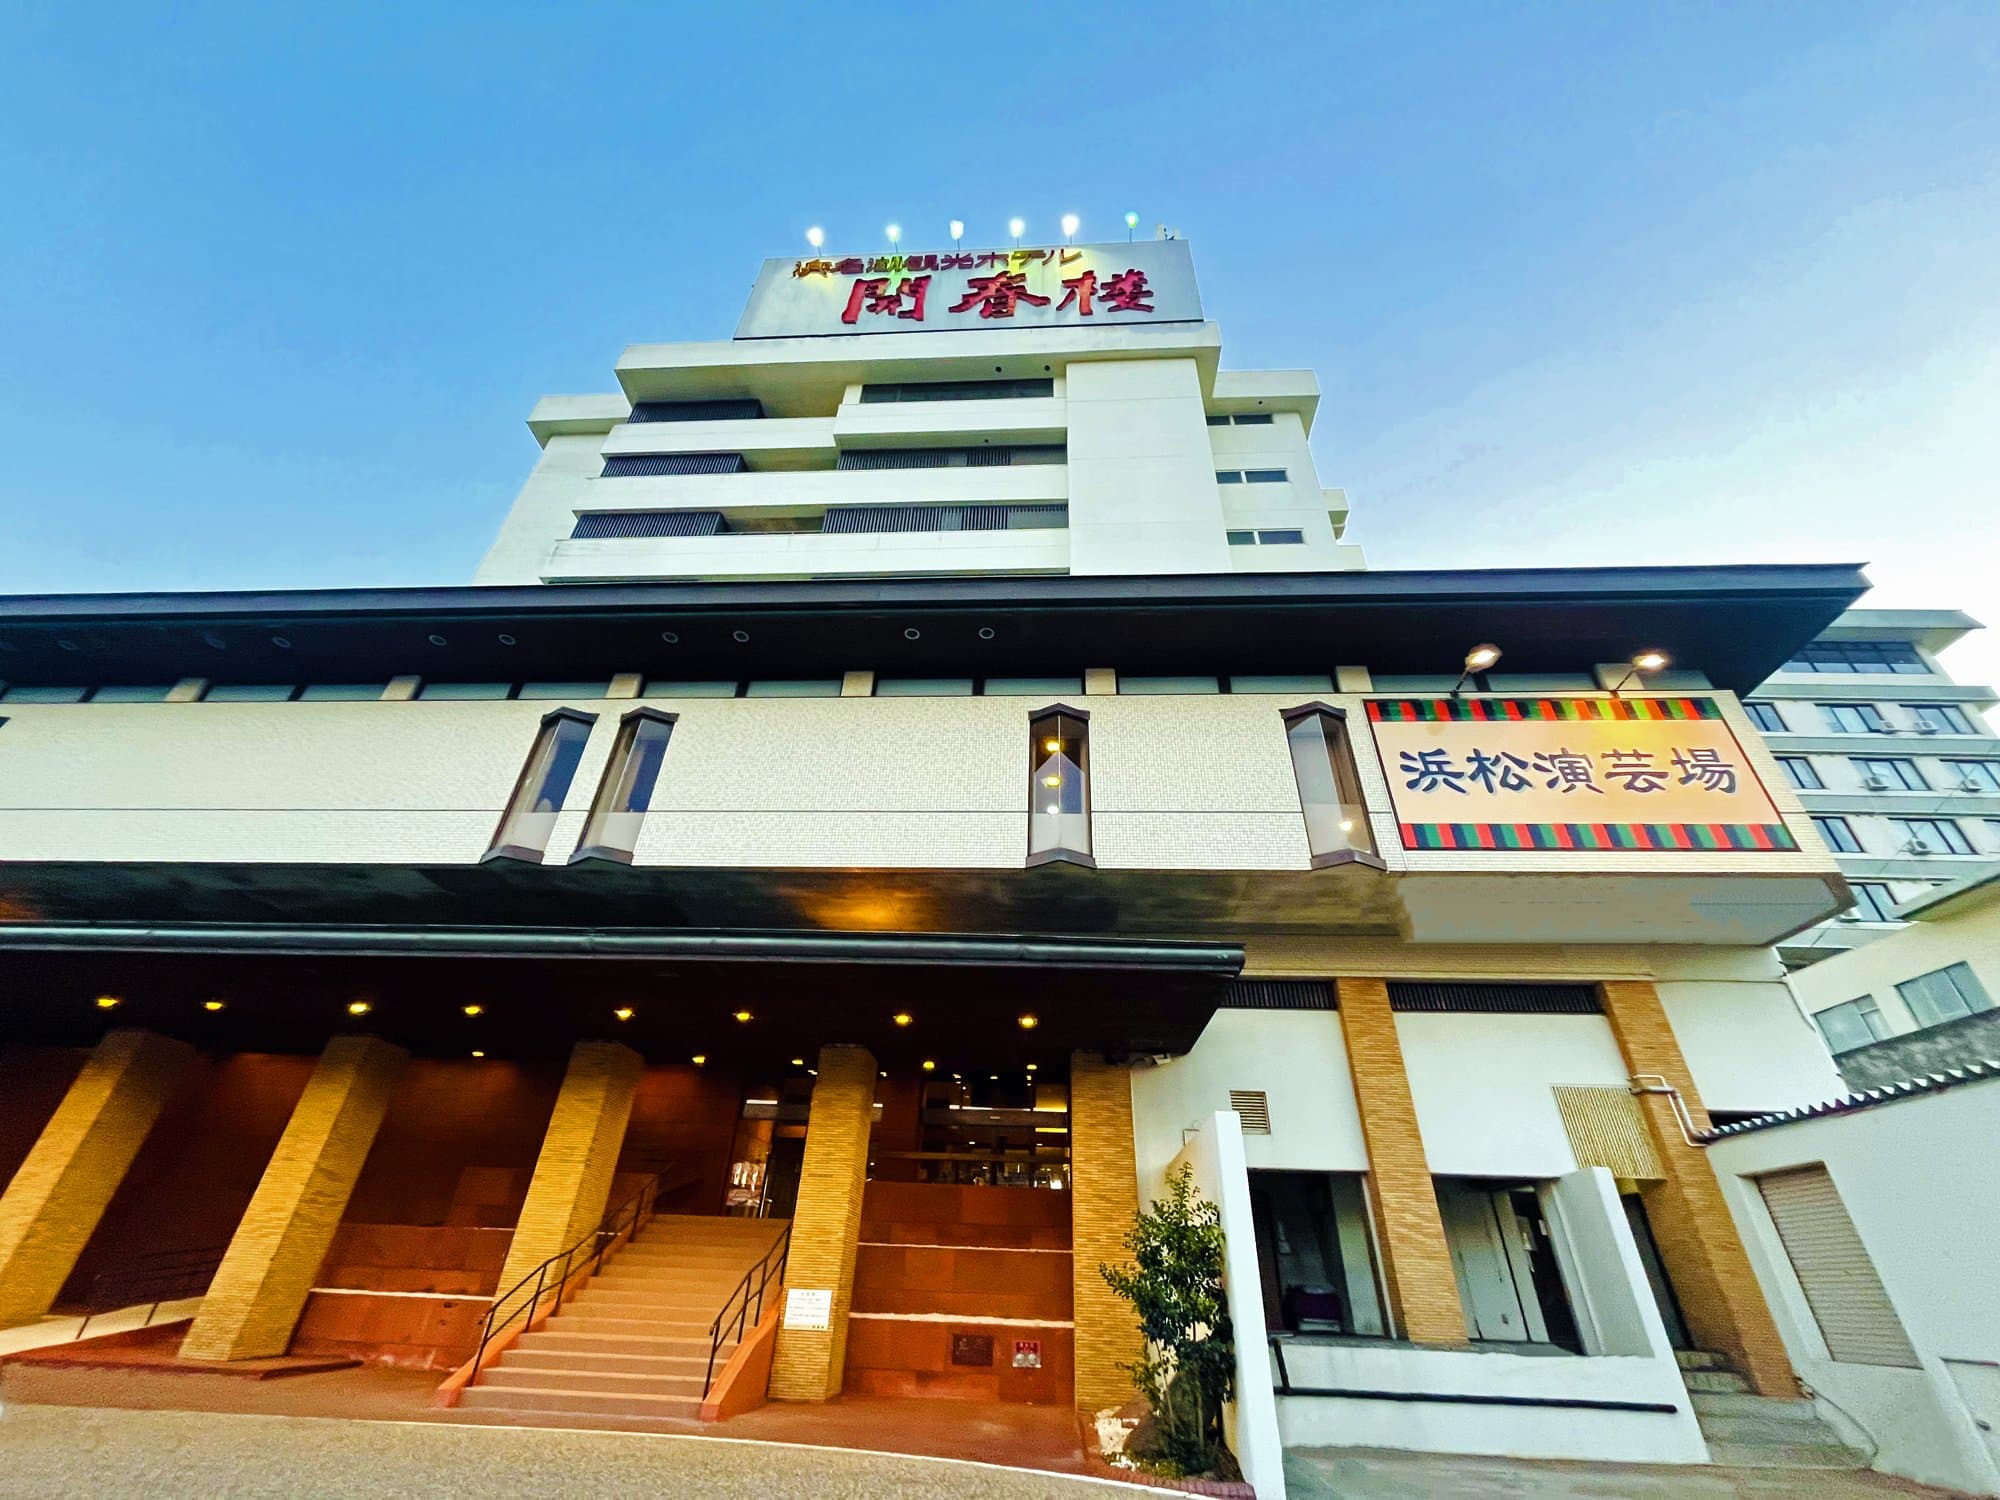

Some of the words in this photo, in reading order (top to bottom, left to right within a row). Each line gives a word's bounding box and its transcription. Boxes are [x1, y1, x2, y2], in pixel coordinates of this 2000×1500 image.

[1399, 747, 1738, 794] 浜松演芸場
